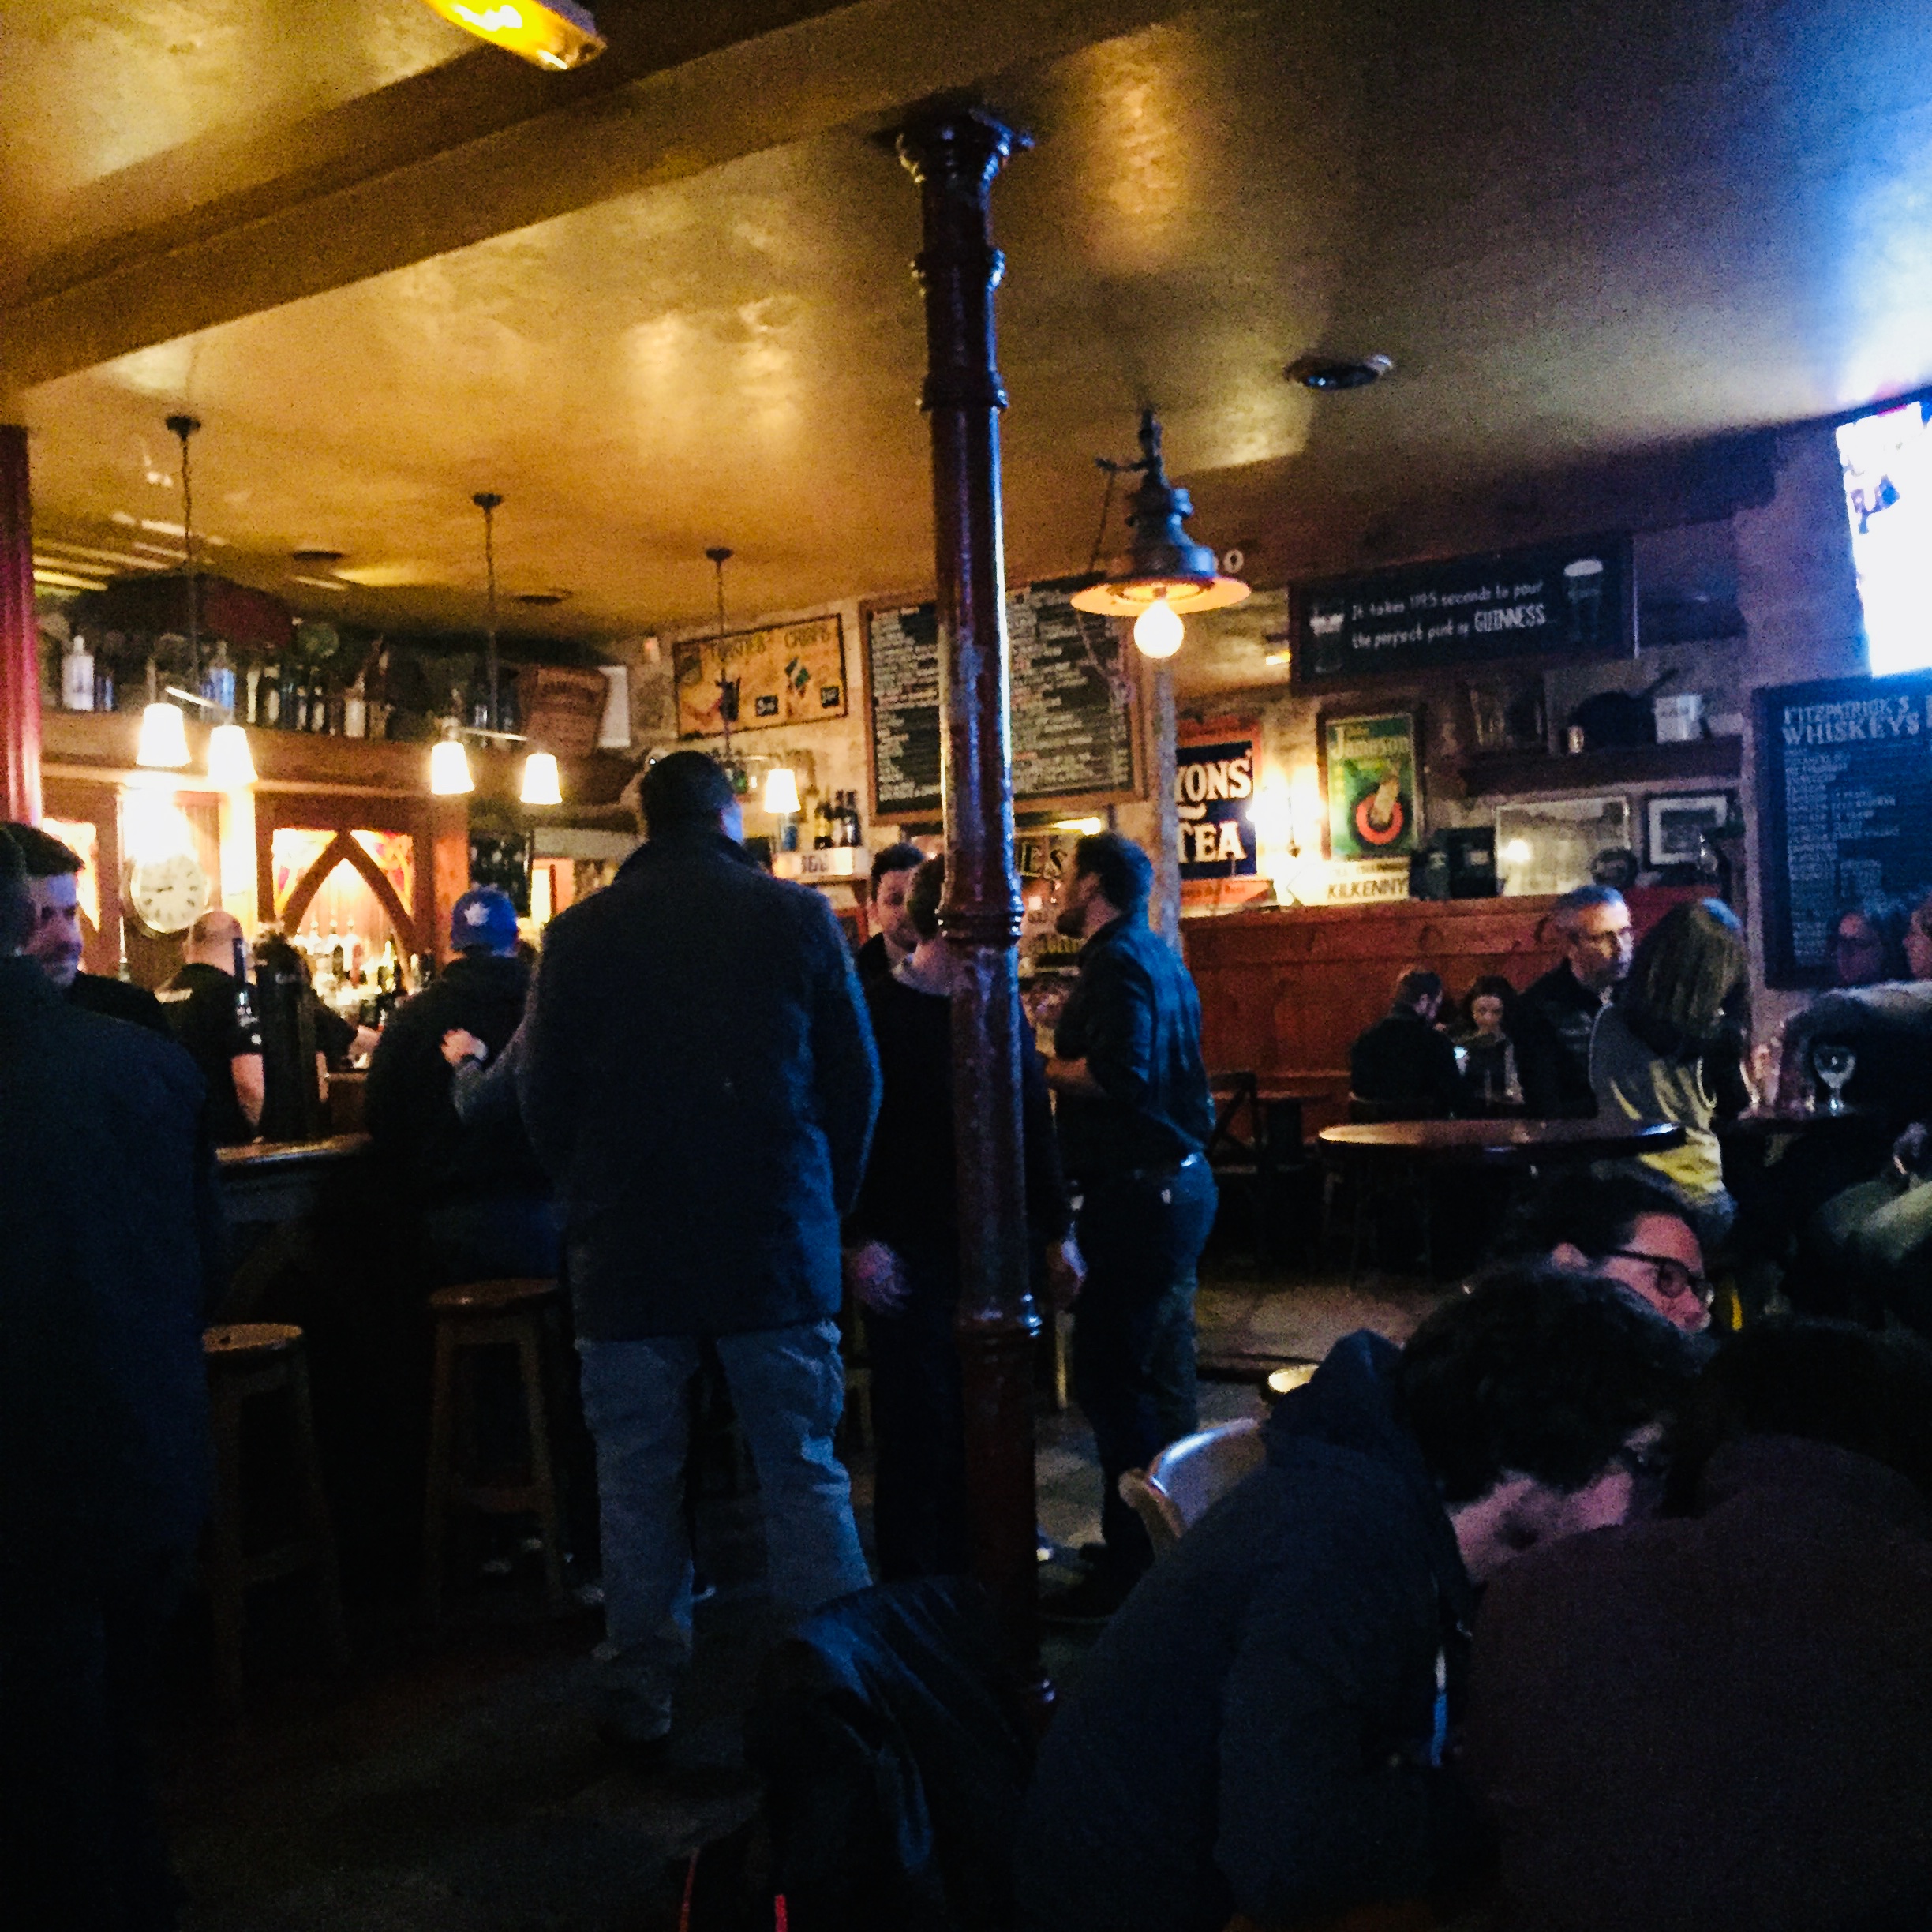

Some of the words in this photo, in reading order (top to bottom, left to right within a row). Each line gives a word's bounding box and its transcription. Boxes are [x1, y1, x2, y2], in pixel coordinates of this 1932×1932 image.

[1474, 602, 1546, 632] GUINNESS
[1781, 711, 1920, 745] WHISKEYS
[1178, 820, 1248, 863] TEA
[1327, 878, 1407, 900] KILKENNY
